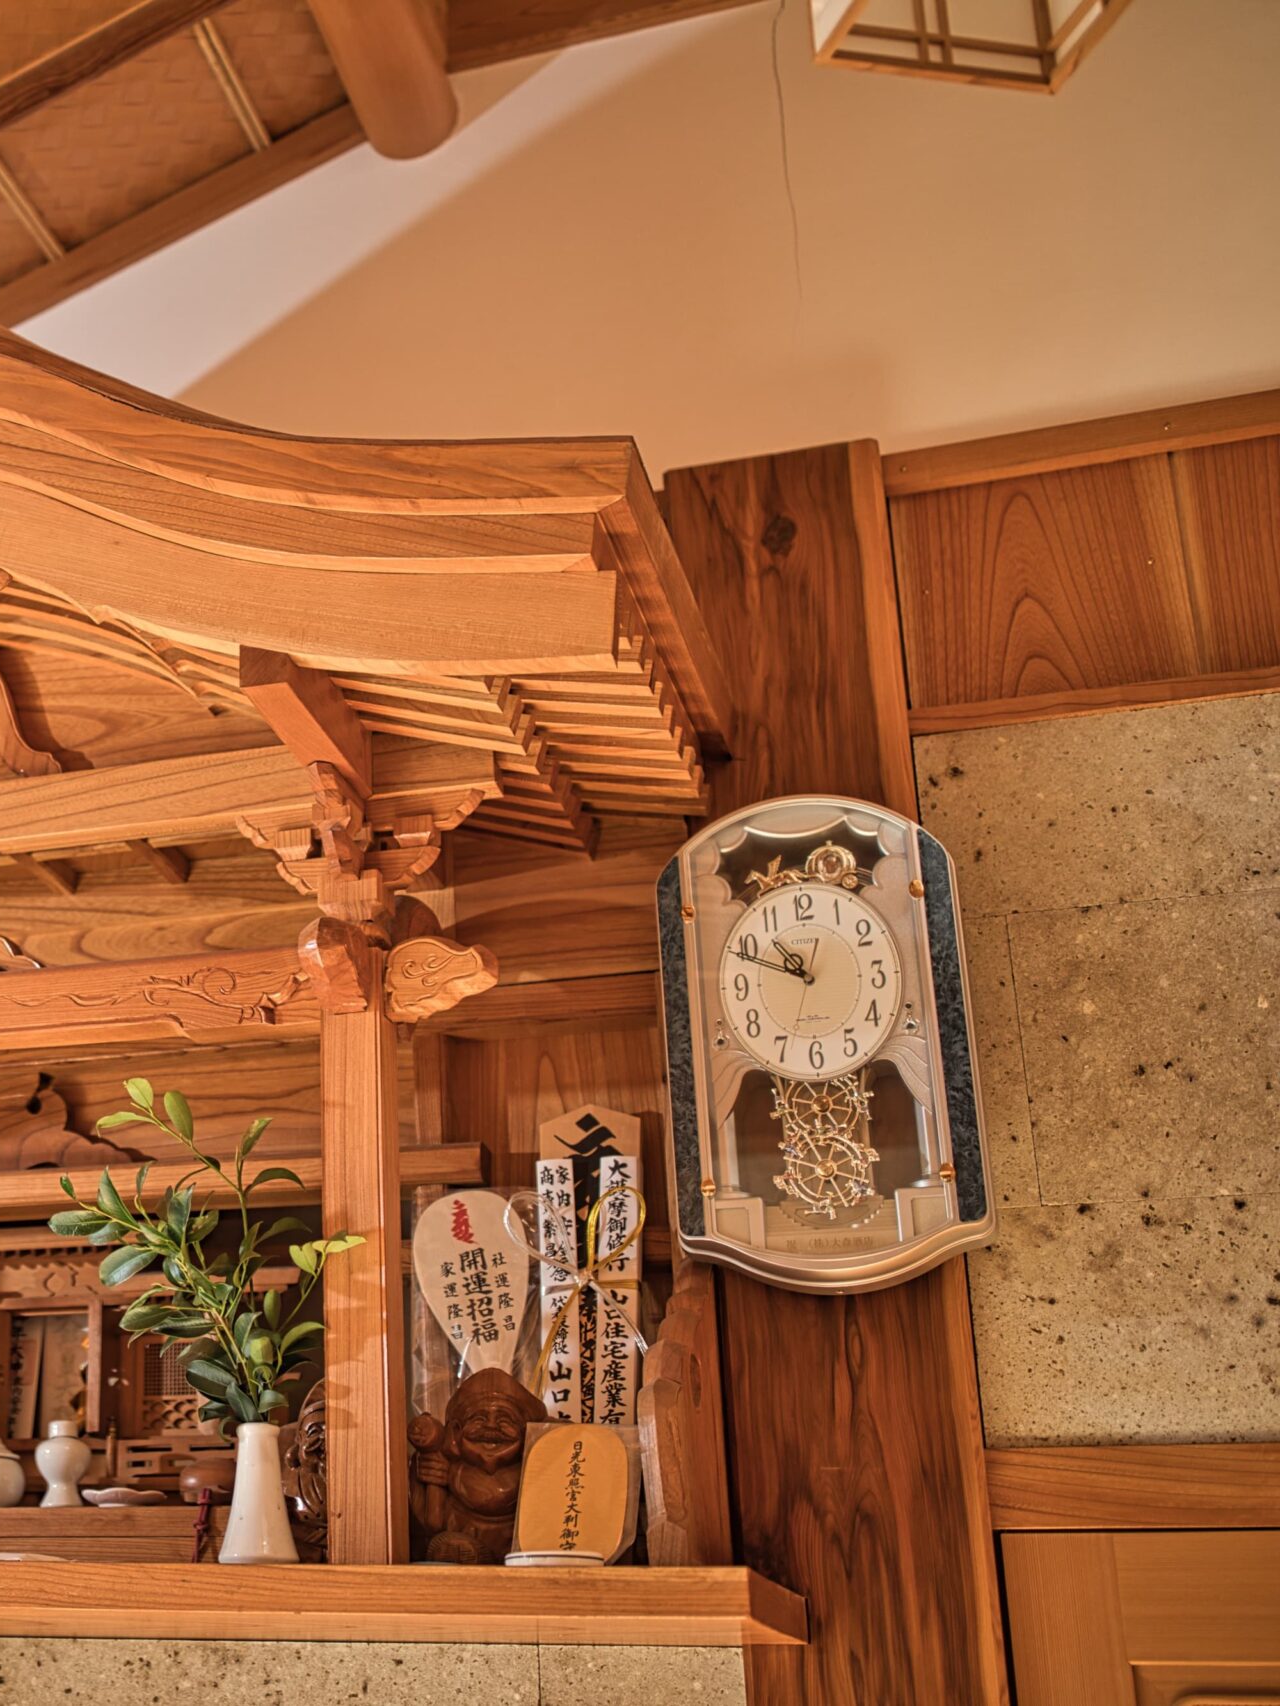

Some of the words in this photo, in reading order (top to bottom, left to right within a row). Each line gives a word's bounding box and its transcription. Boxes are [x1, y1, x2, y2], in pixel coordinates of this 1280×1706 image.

[762, 905, 778, 933] 11
[794, 893, 815, 921] 12
[834, 898, 840, 926] 1
[739, 933, 758, 961] 10
[791, 937, 819, 946] CITIZE
[855, 919, 873, 947] 2
[734, 973, 749, 1001] 9
[871, 960, 886, 989] 3
[746, 1008, 760, 1038] 8
[864, 999, 881, 1027] 4
[774, 1035, 788, 1063] 7
[808, 1041, 824, 1070] 6
[843, 1027, 858, 1057] 5
[440, 1261, 464, 1340] 家運隆昌
[458, 1247, 499, 1345] 開運招福
[491, 1252, 516, 1331] 社運隆昌
